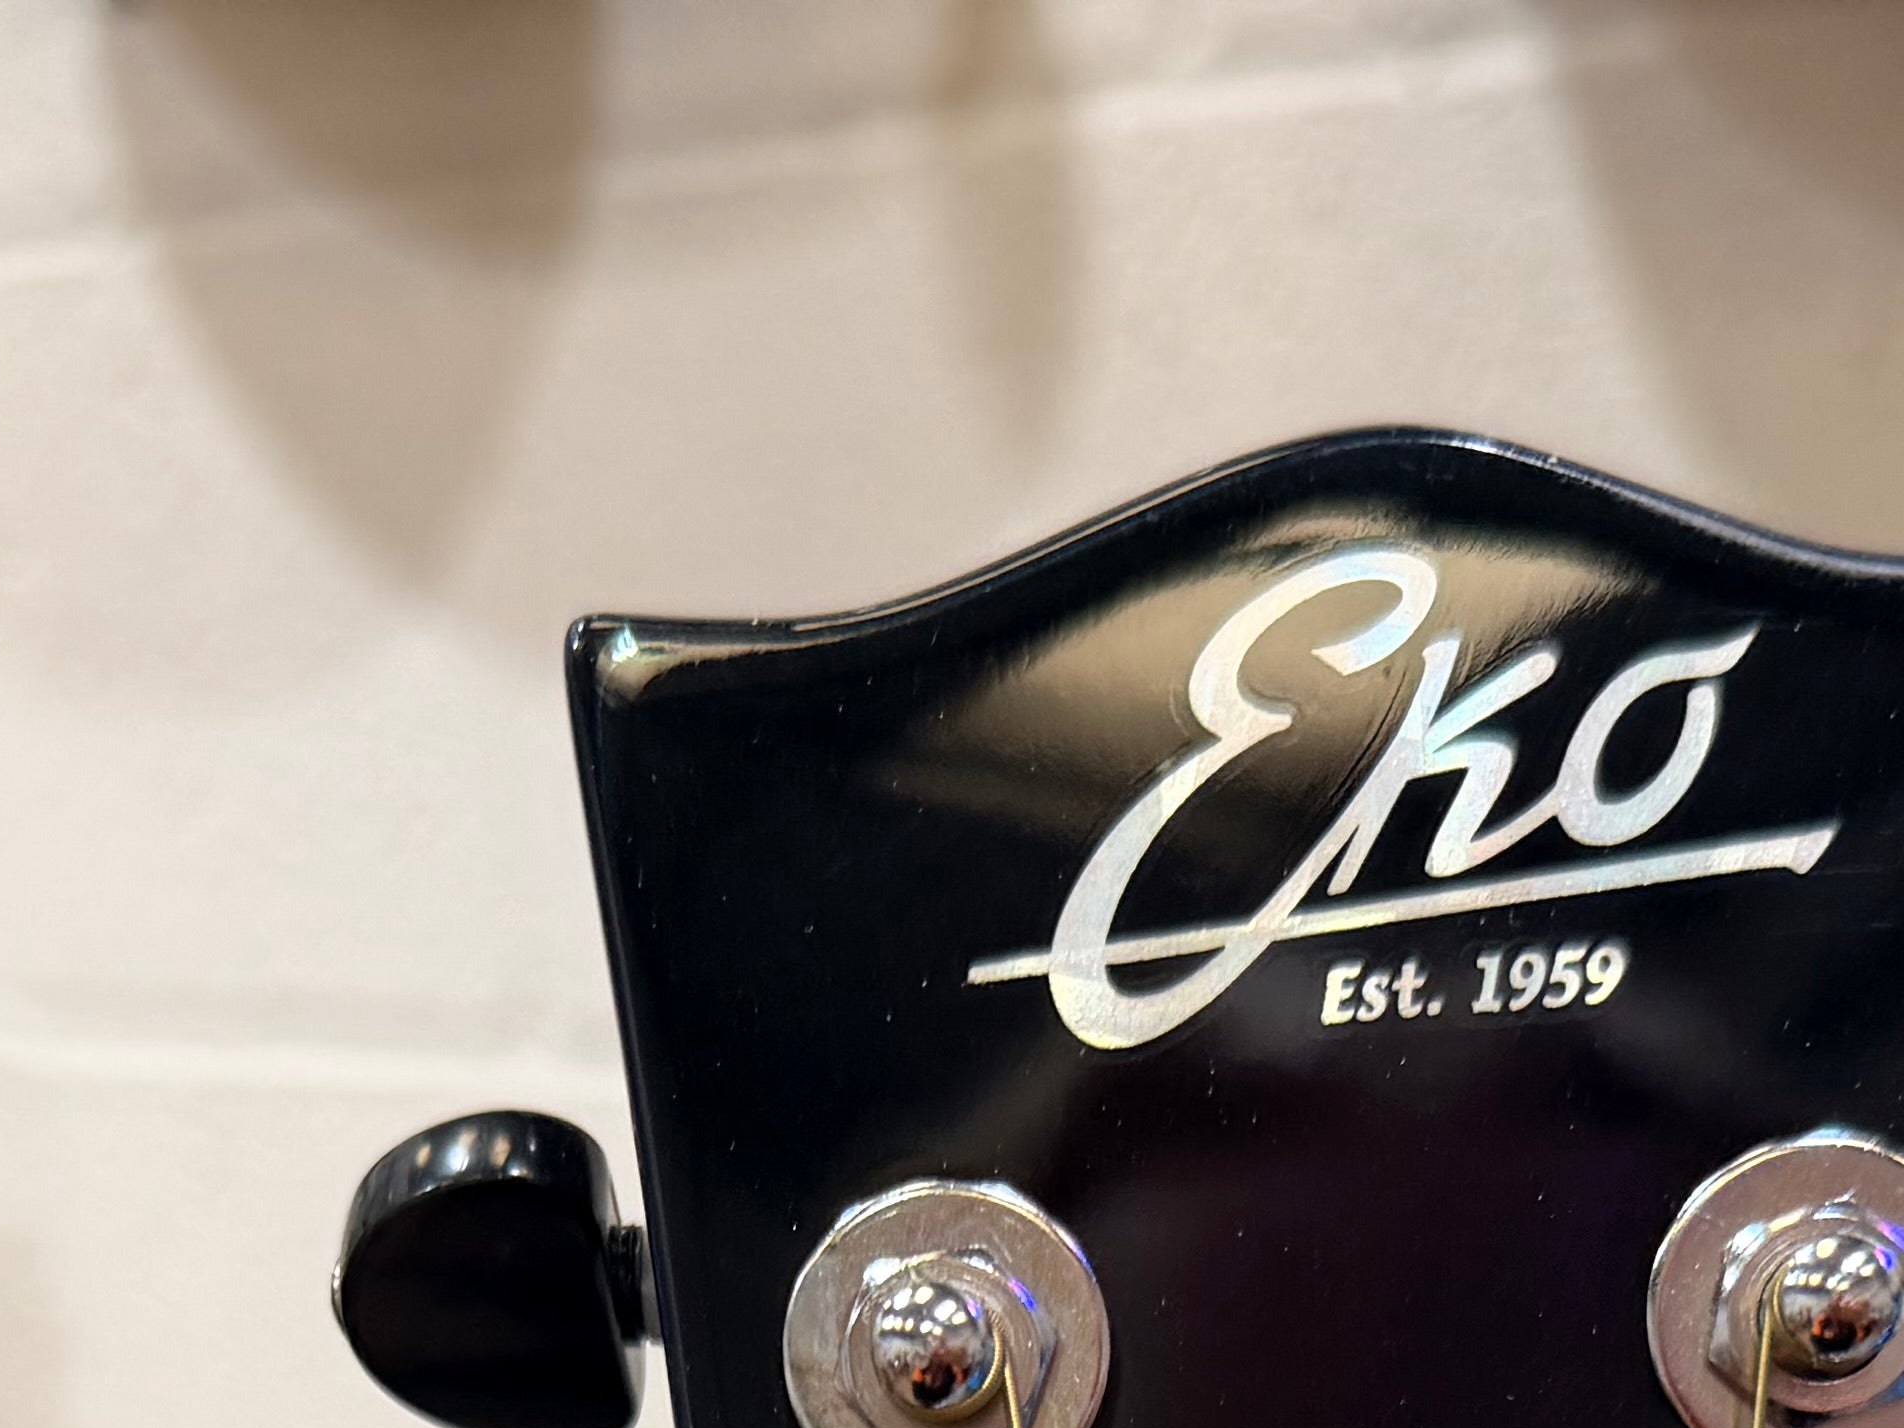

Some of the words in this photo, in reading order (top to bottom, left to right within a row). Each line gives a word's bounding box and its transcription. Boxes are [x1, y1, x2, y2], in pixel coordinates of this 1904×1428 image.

[1026, 548, 1786, 1052] Eko
[1320, 955, 1444, 1026] Est.
[1471, 938, 1631, 1015] 1959
